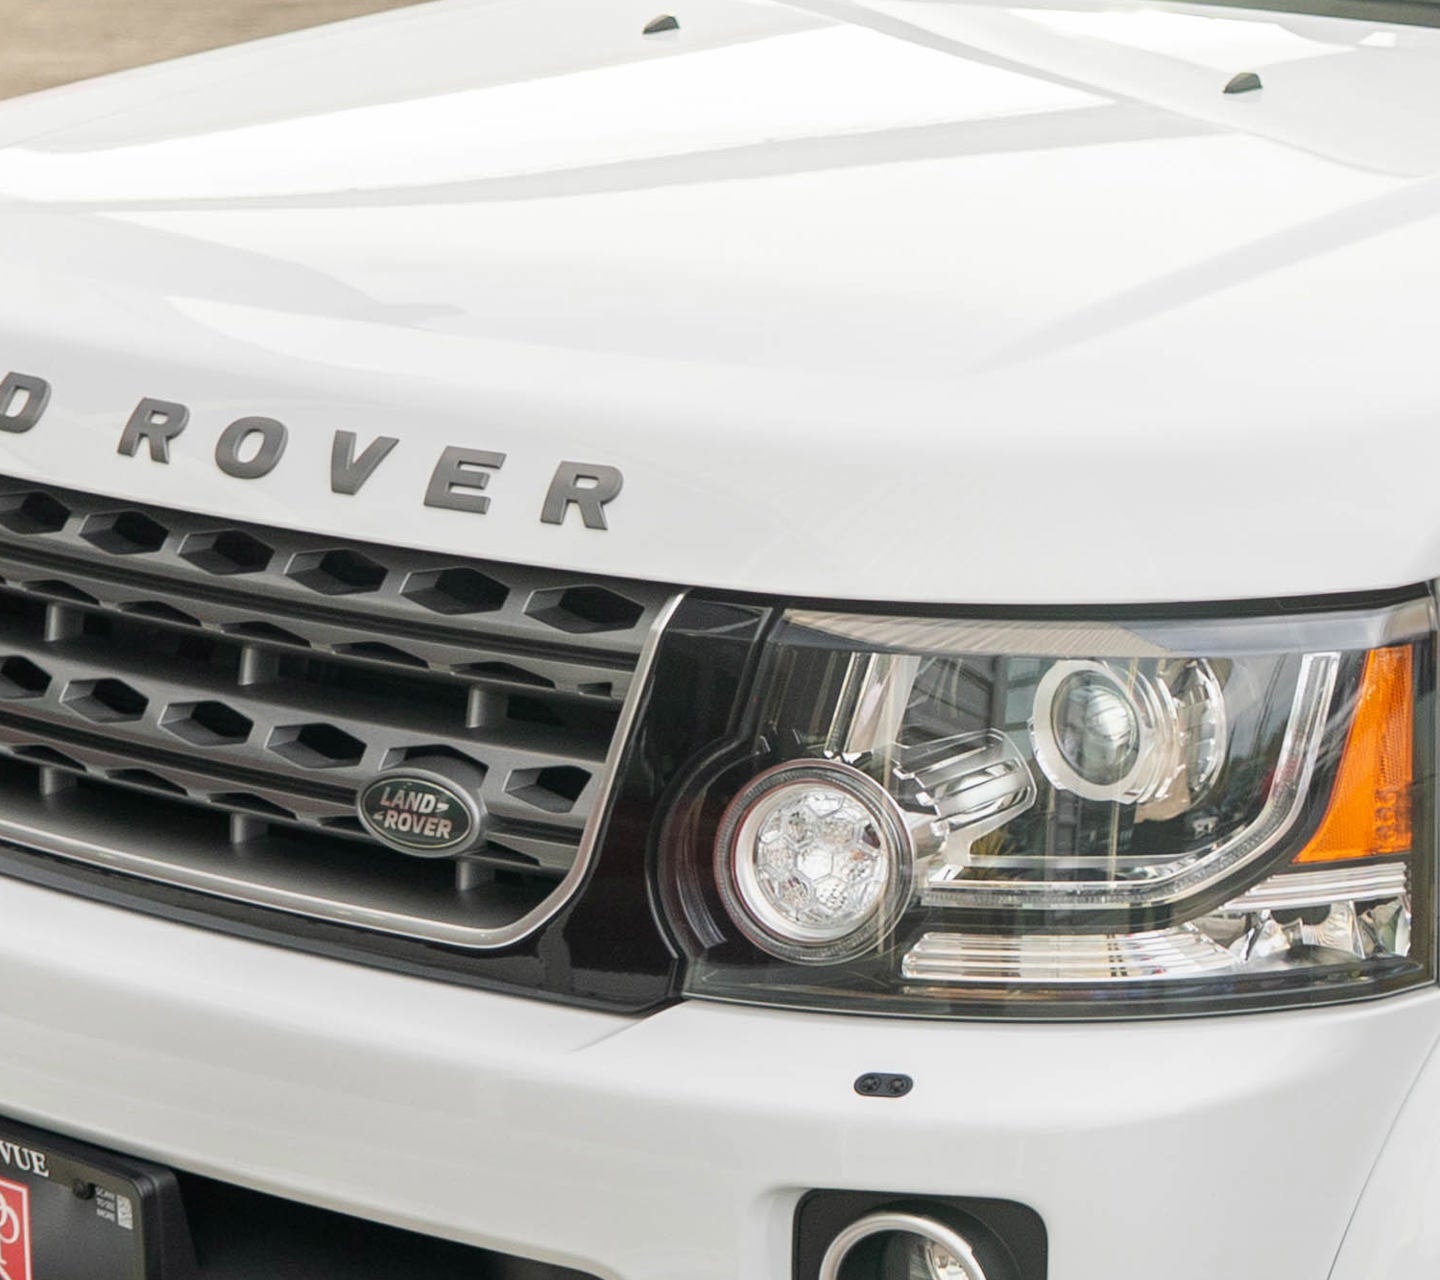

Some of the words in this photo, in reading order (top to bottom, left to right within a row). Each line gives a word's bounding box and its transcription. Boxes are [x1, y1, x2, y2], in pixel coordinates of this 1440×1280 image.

[117, 396, 624, 532] ROVER
[380, 786, 434, 814] LAND
[383, 809, 453, 840] ROVER
